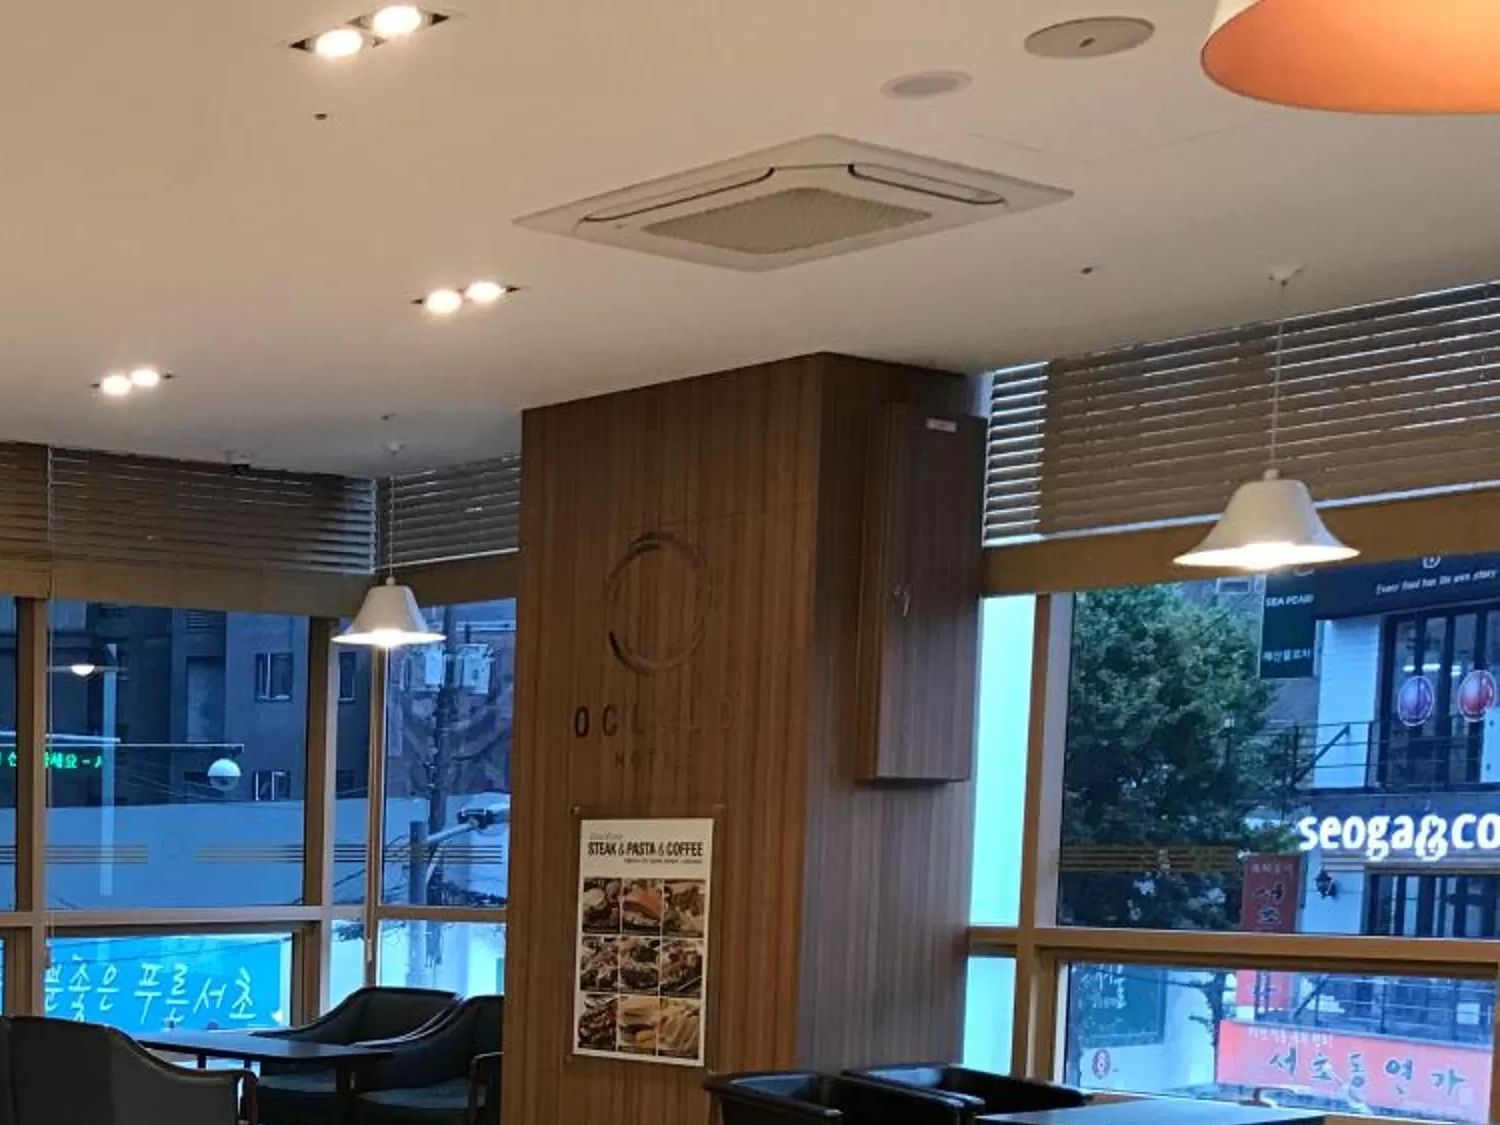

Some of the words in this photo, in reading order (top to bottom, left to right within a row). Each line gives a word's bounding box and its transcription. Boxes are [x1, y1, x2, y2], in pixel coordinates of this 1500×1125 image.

[588, 841, 617, 856] STEAK
[626, 841, 657, 856] PASTA
[666, 841, 704, 857] COFFEE
